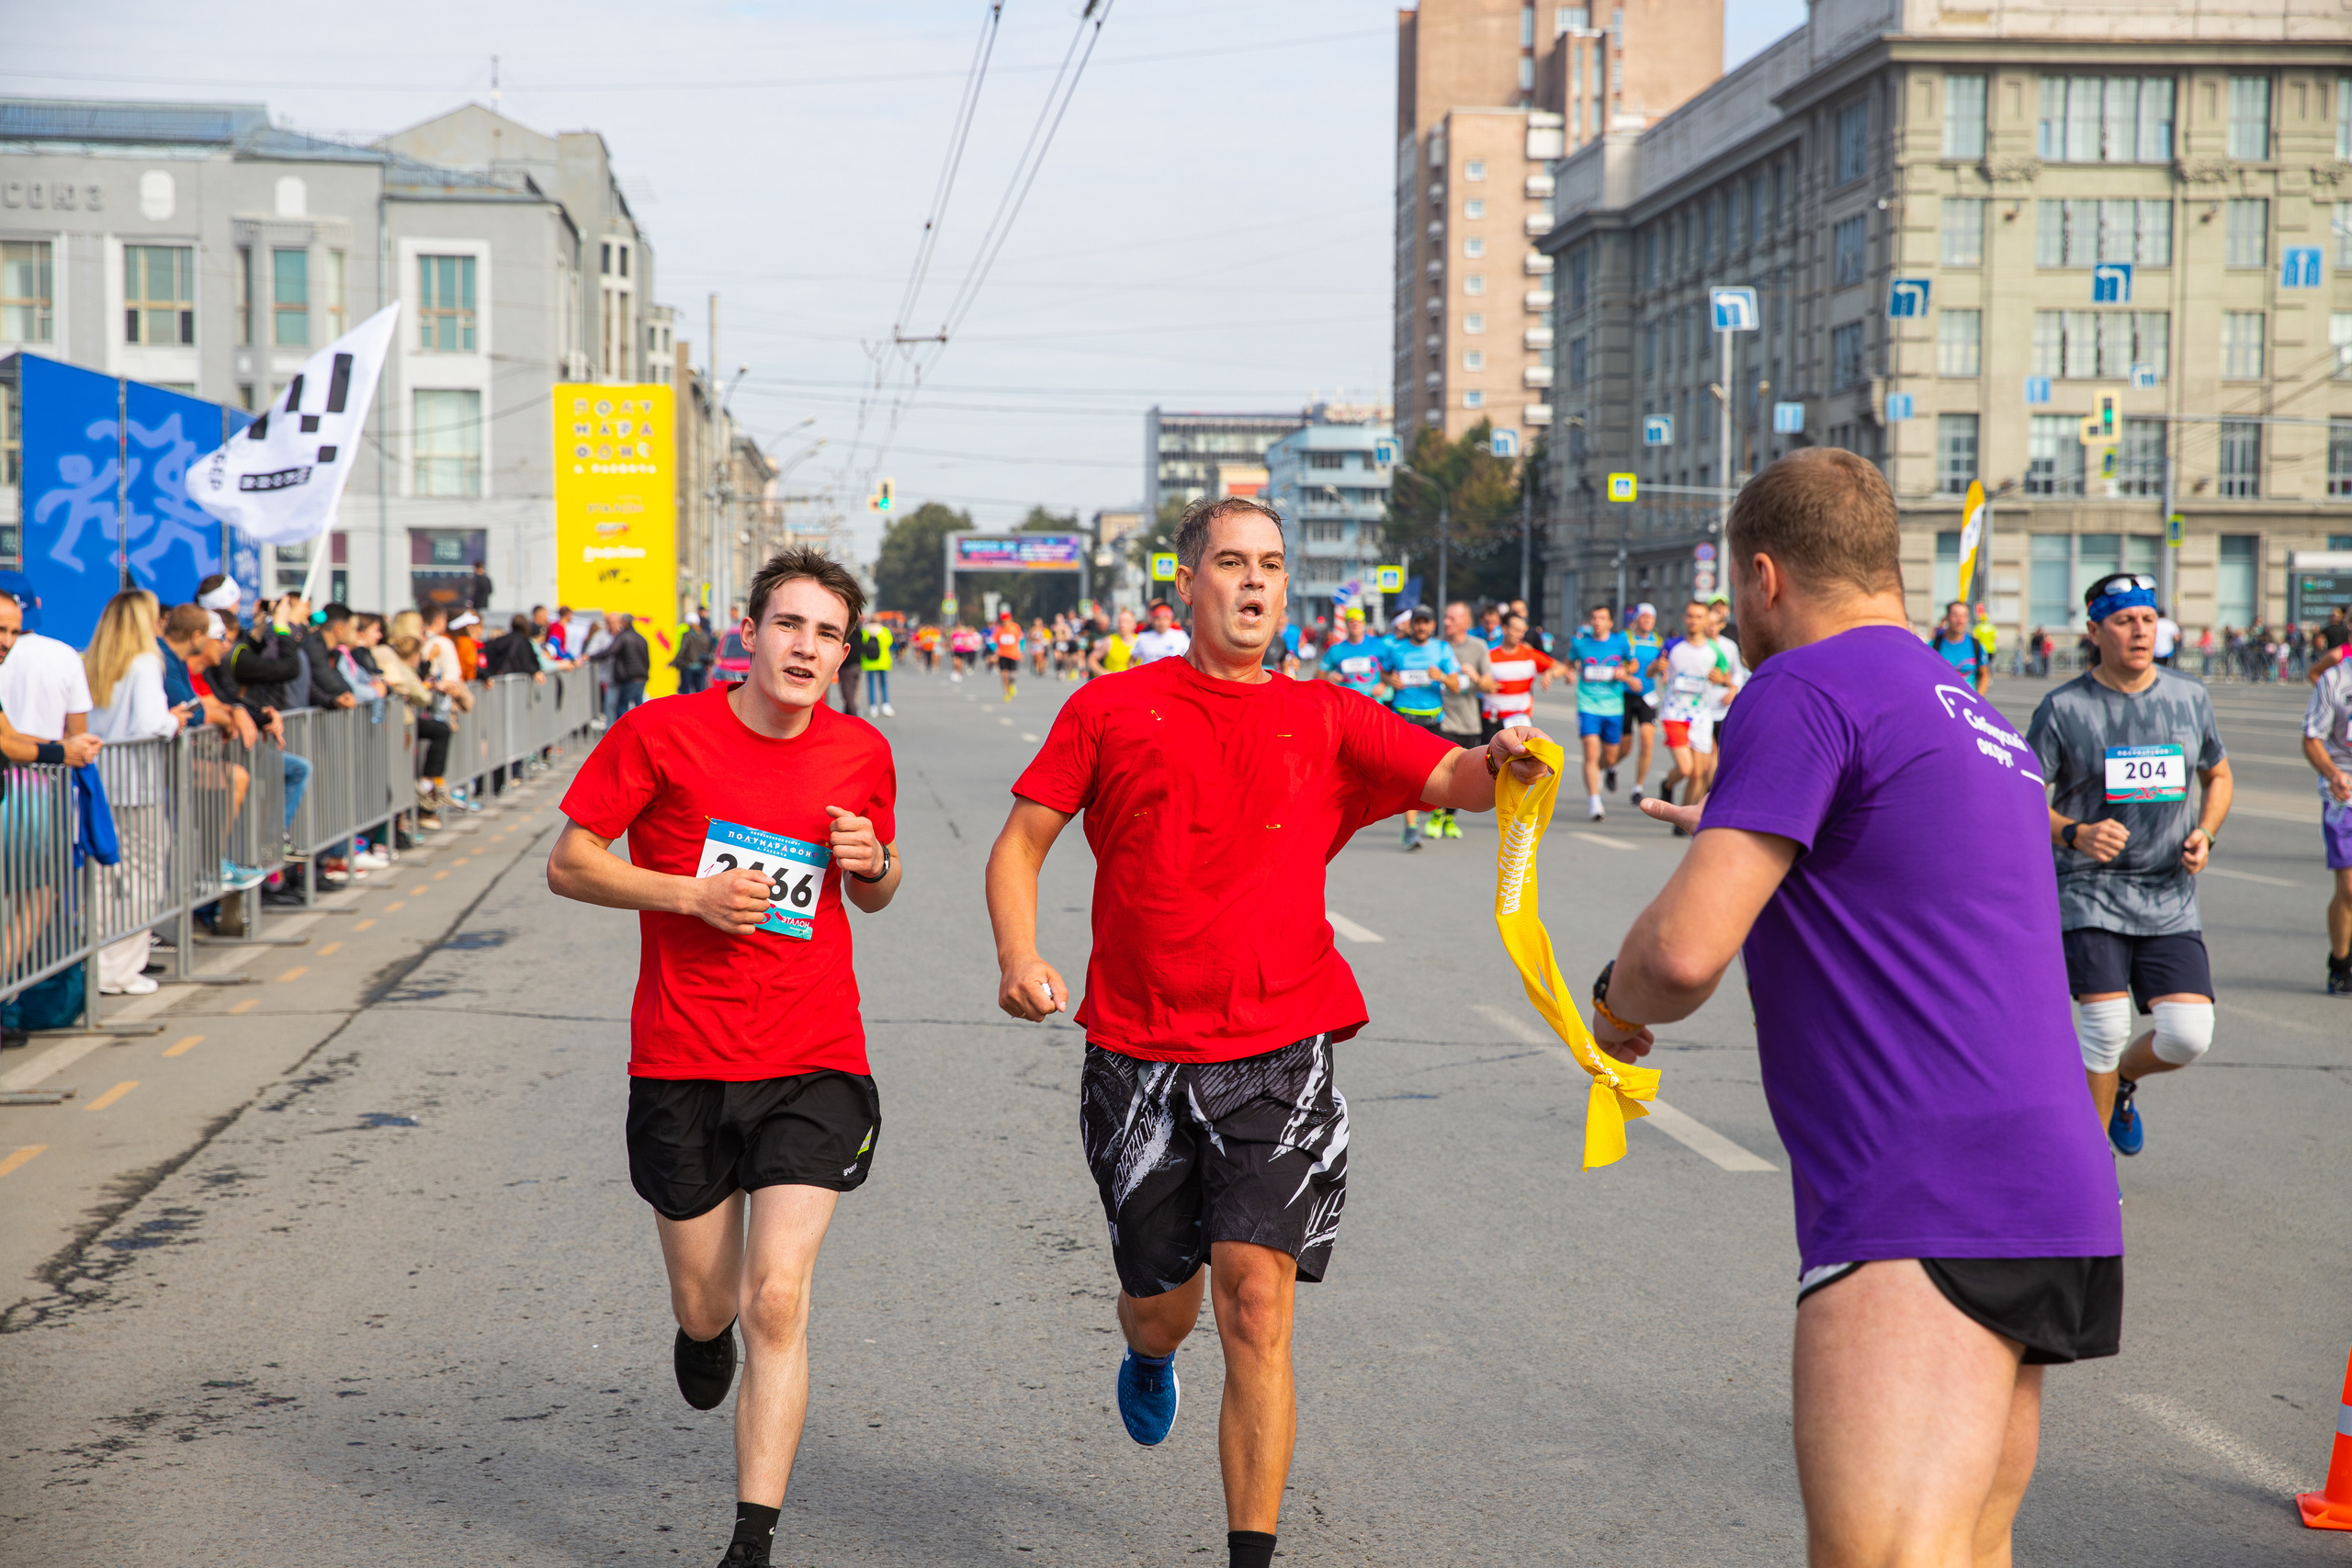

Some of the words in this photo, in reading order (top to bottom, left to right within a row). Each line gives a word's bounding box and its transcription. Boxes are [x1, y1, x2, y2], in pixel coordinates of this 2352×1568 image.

[2, 181, 105, 211] СОЮЗ
[2125, 761, 2166, 779] 204
[728, 831, 811, 858] ПОЛУМАРАФОН
[781, 916, 810, 929] ЭТАЛОН
